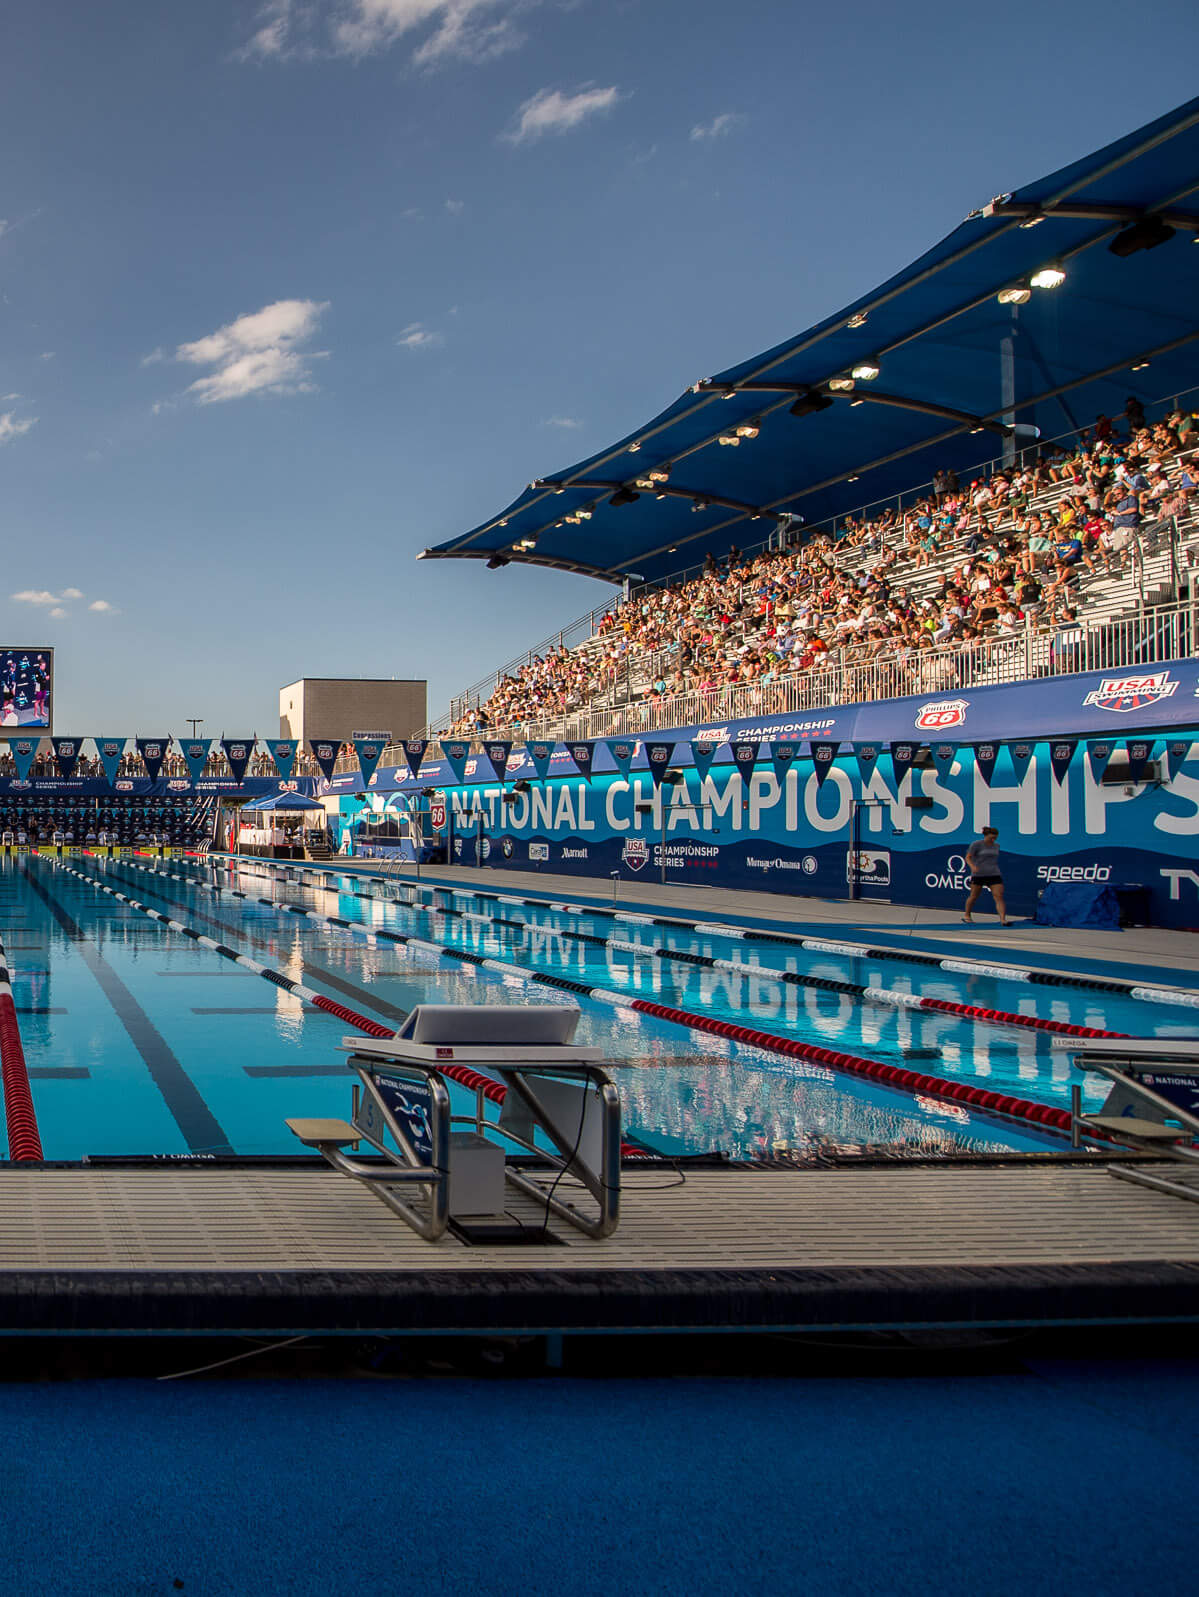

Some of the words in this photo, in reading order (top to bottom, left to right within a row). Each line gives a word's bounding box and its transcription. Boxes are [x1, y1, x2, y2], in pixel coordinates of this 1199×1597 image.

[1106, 677, 1156, 692] USA
[1093, 685, 1167, 699] SWIMMING
[925, 703, 960, 713] PHILLIPS
[924, 711, 957, 725] 66
[699, 731, 722, 739] USA
[737, 719, 836, 738] CHAMPIONSHIP
[452, 784, 595, 831] NATIONAL
[432, 808, 445, 823] 66
[628, 841, 644, 851] USA
[654, 857, 685, 868] SERIES
[1037, 864, 1110, 883] speedo
[1155, 1076, 1198, 1087] NATIONAL
